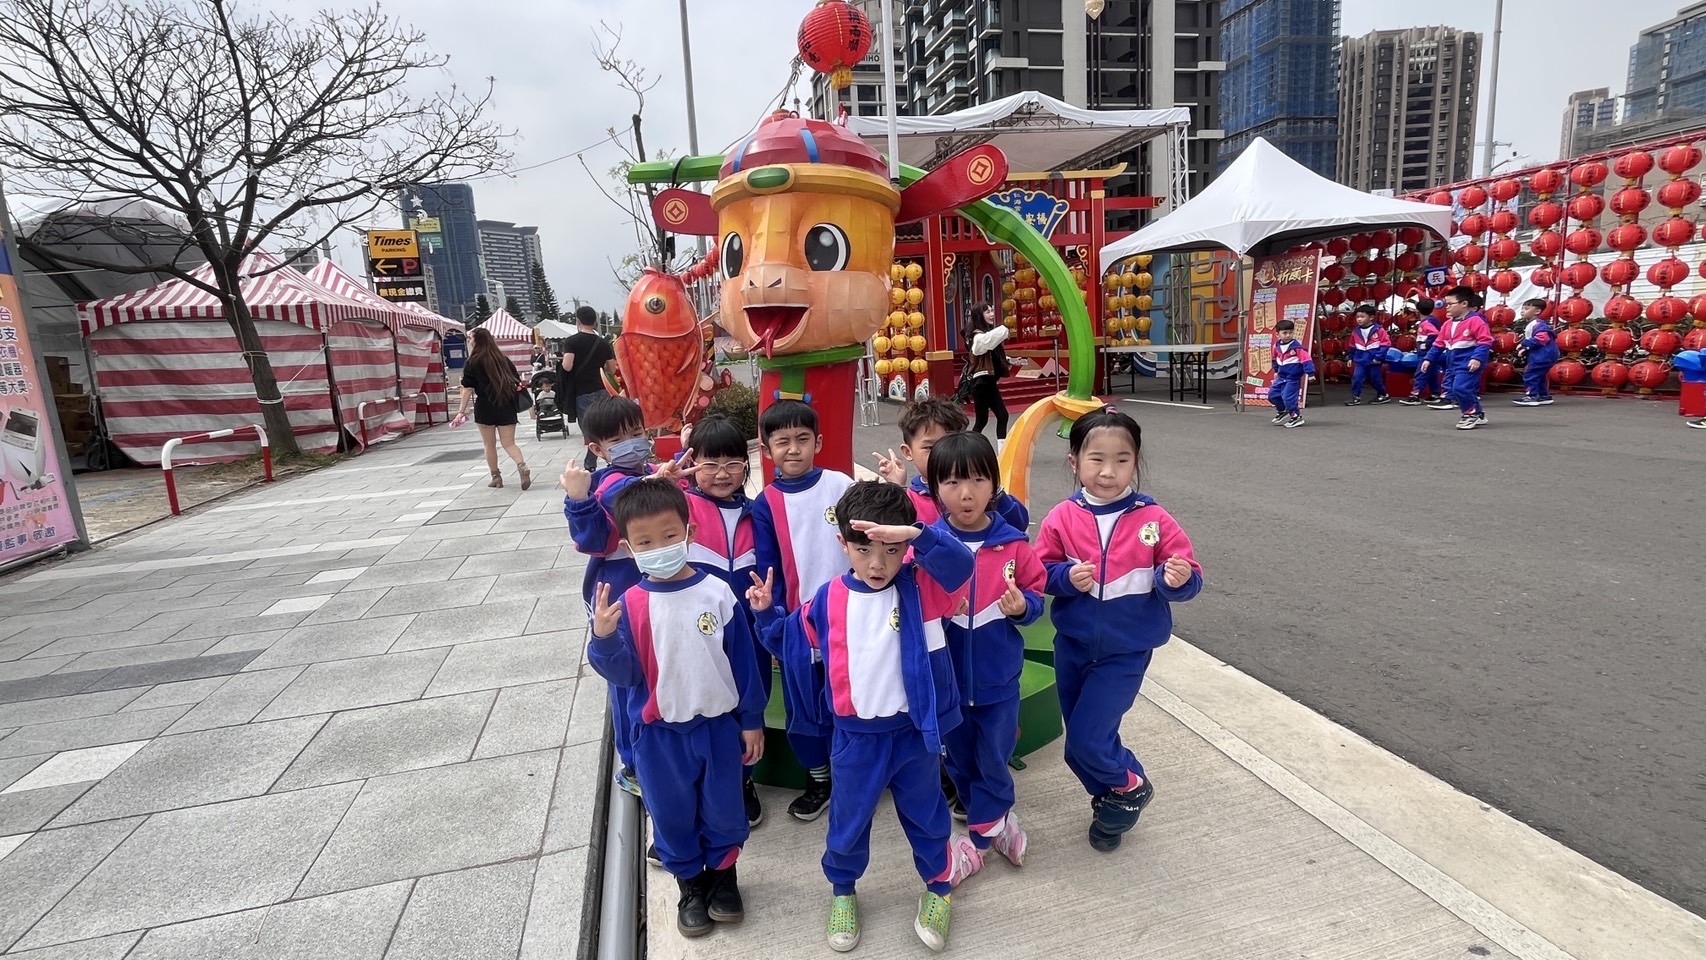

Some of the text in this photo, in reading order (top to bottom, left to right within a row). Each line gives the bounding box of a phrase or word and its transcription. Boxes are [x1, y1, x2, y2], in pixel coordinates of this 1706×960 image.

[373, 236, 412, 246] Times
[402, 258, 418, 275] P
[1432, 272, 1442, 283] 兵
[379, 286, 424, 297] 無現金繳費
